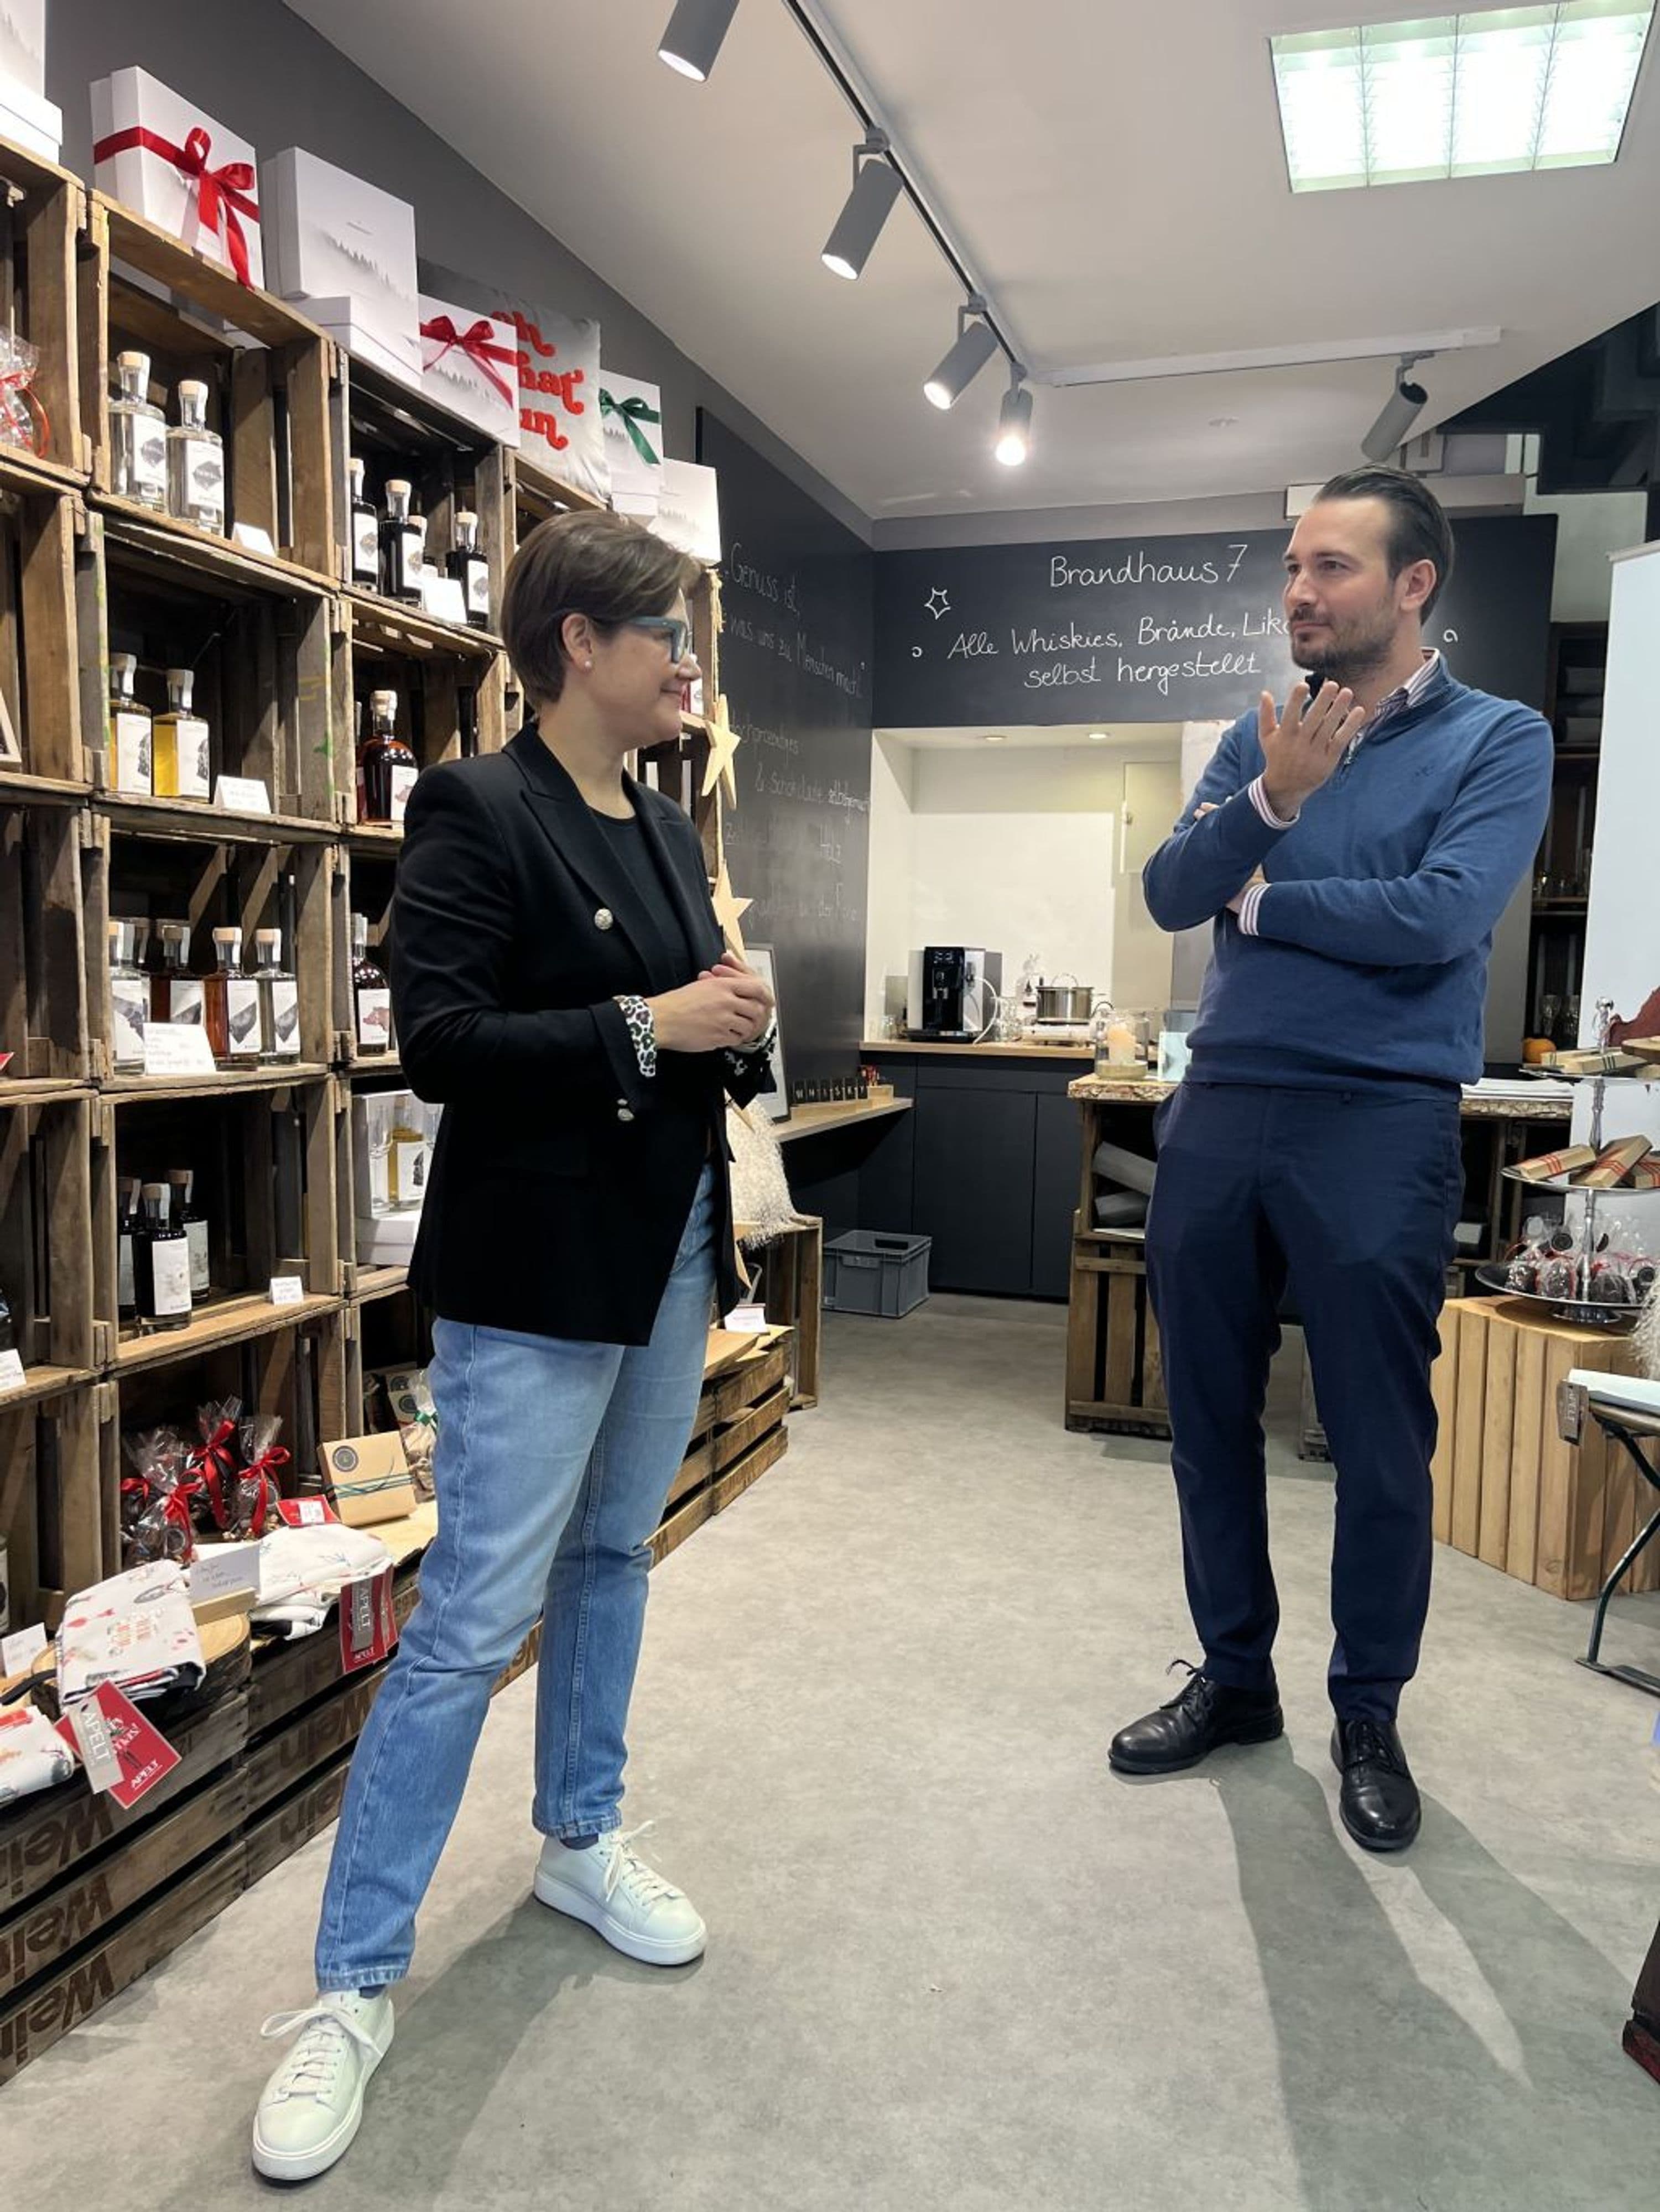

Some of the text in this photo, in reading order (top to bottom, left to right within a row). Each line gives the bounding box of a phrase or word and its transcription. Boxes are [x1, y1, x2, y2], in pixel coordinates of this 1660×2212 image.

[1050, 544, 1248, 587] Brandhaus 7
[946, 631, 1000, 659] Alle
[1023, 650, 1262, 696] selbst hergestellt
[82, 1712, 111, 1765] APELT
